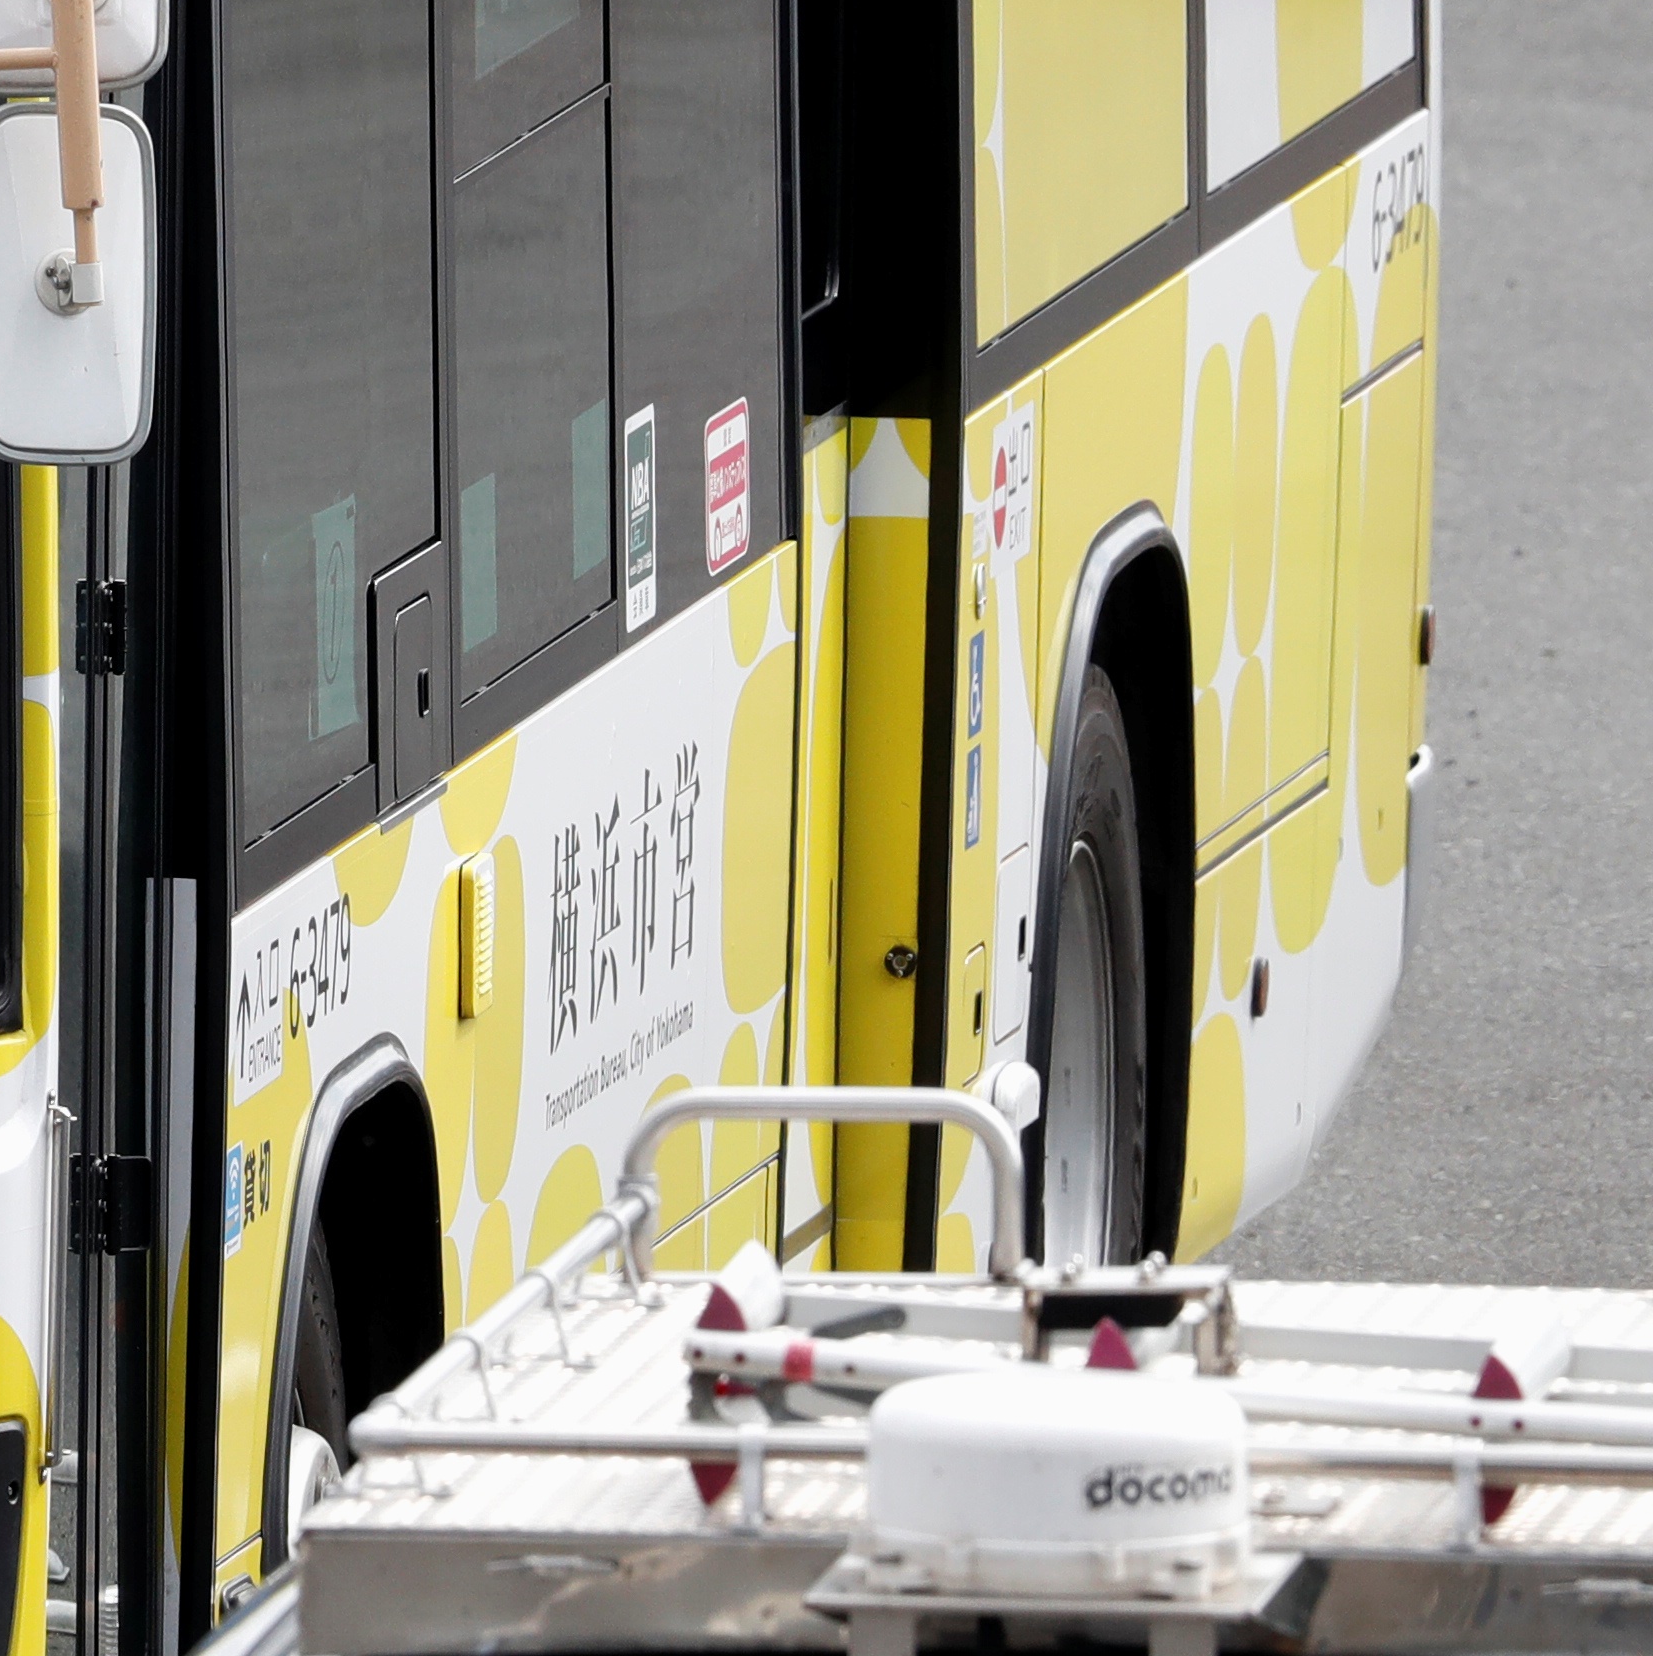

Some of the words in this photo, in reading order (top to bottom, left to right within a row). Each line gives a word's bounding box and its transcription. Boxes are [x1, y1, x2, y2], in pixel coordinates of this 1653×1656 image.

[1371, 144, 1425, 273] 6-3479
[631, 457, 650, 511] NBA
[1007, 421, 1031, 499] 出口
[1009, 506, 1027, 550] EXIT
[547, 739, 701, 1057] 横浜市営
[253, 938, 281, 1023] 入口
[288, 892, 352, 1040] 6-3479
[248, 1023, 283, 1083] ENTRANCE
[545, 1061, 598, 1131] Transportation
[599, 1039, 627, 1093] Bureau,
[629, 1028, 646, 1079] City
[646, 1016, 656, 1059] of
[656, 999, 694, 1052] Yokohama
[243, 1139, 272, 1228] 貸切
